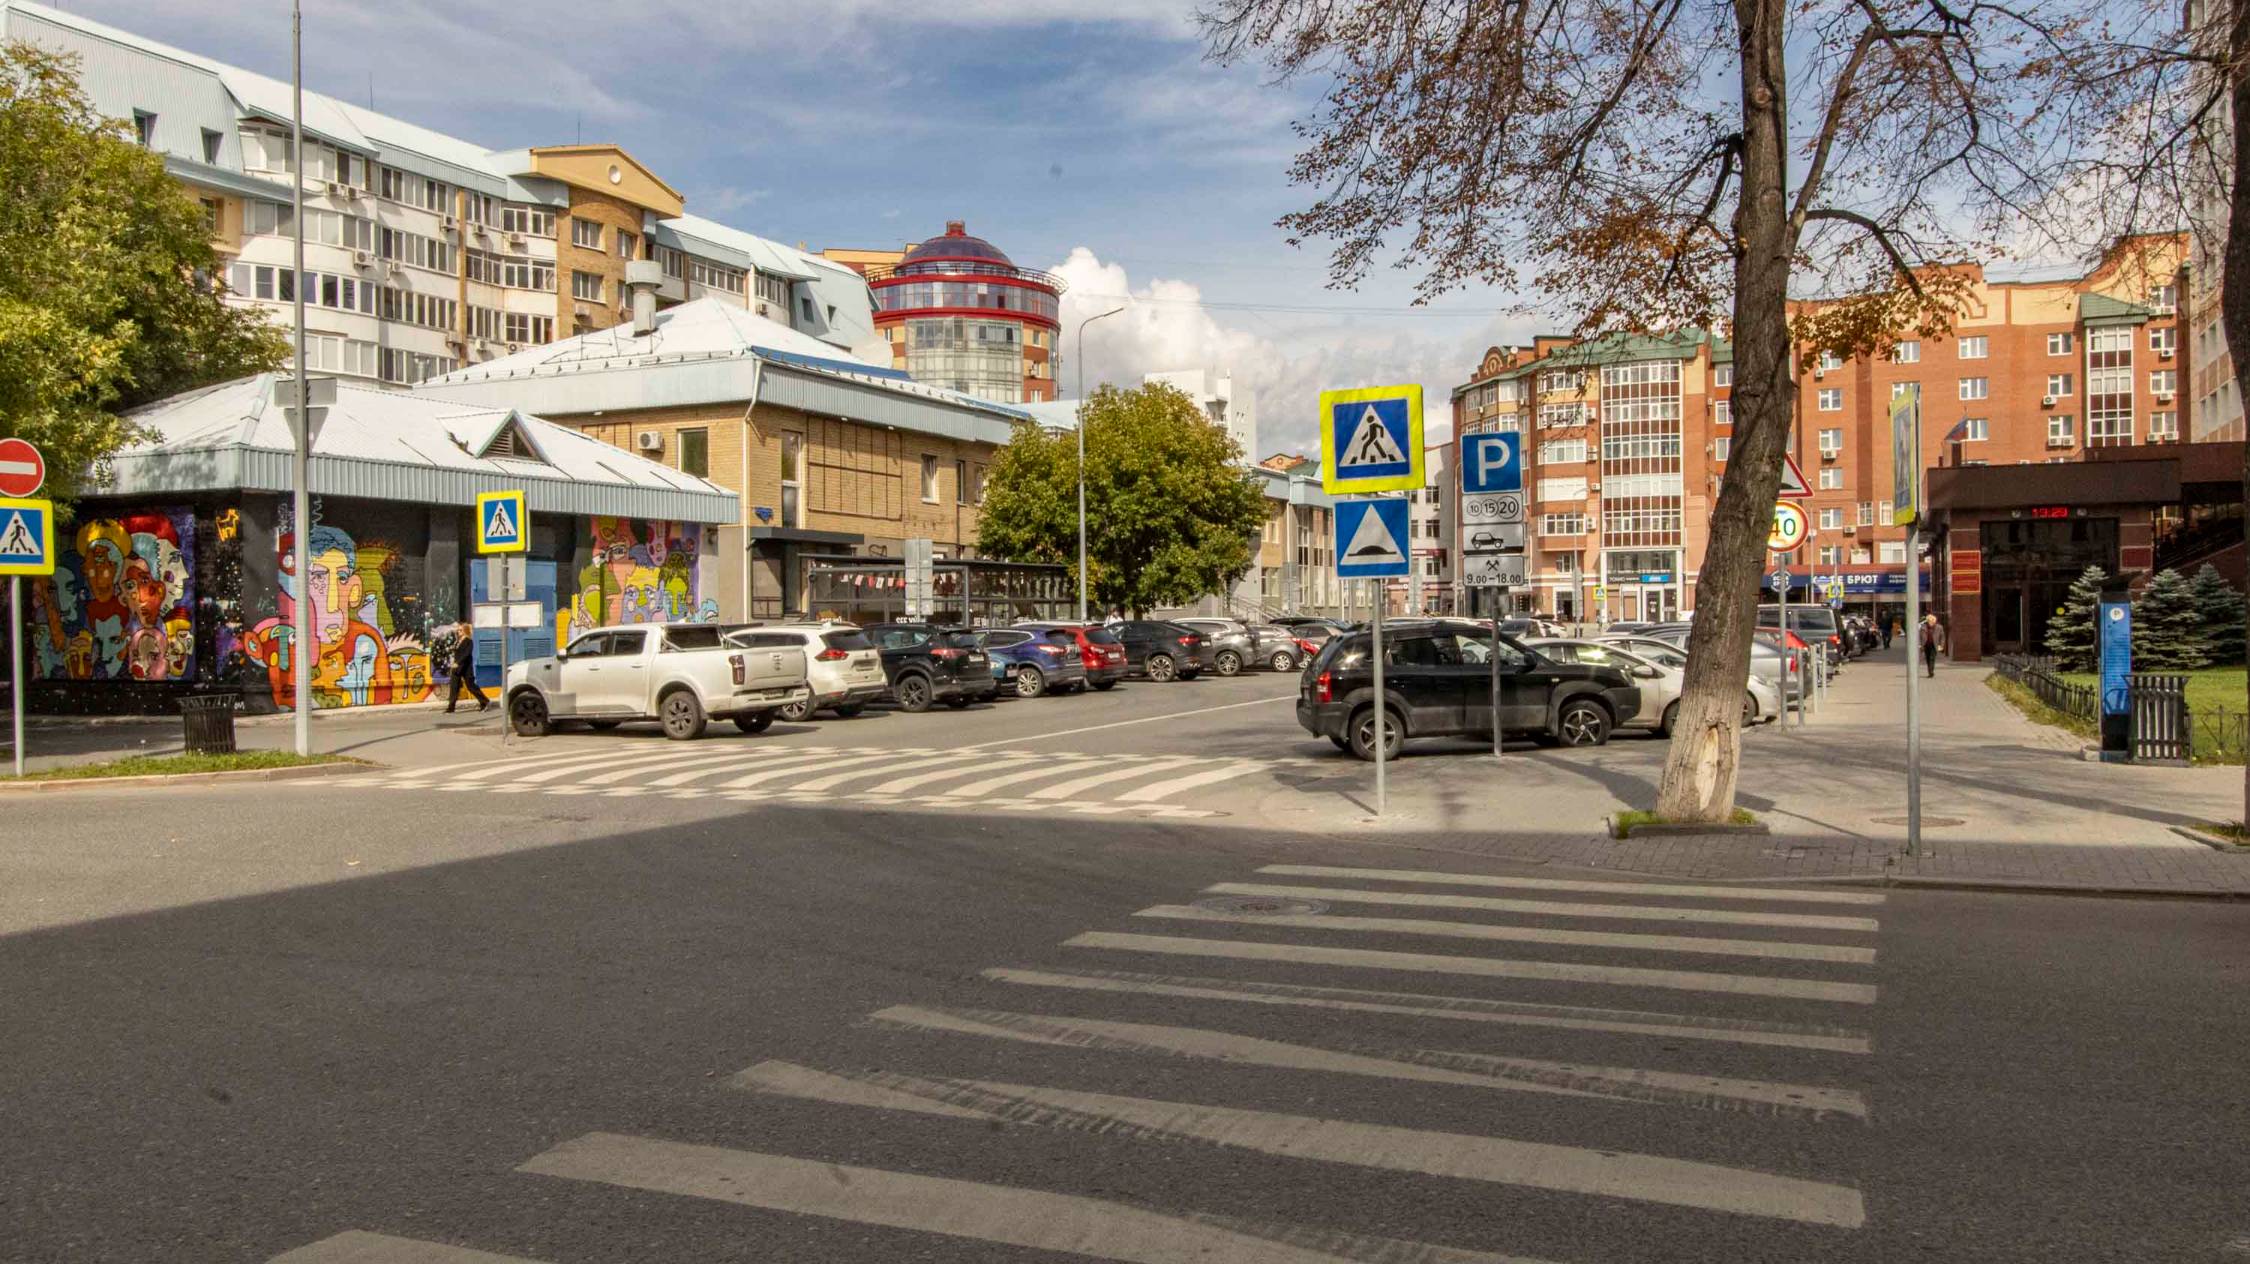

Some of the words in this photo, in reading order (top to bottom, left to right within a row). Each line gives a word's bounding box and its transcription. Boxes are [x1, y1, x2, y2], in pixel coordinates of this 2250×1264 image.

[1478, 439, 1510, 486] P
[1484, 503, 1495, 512] 15
[1499, 501, 1516, 514] 20
[1847, 575, 1879, 585] БРЮТ
